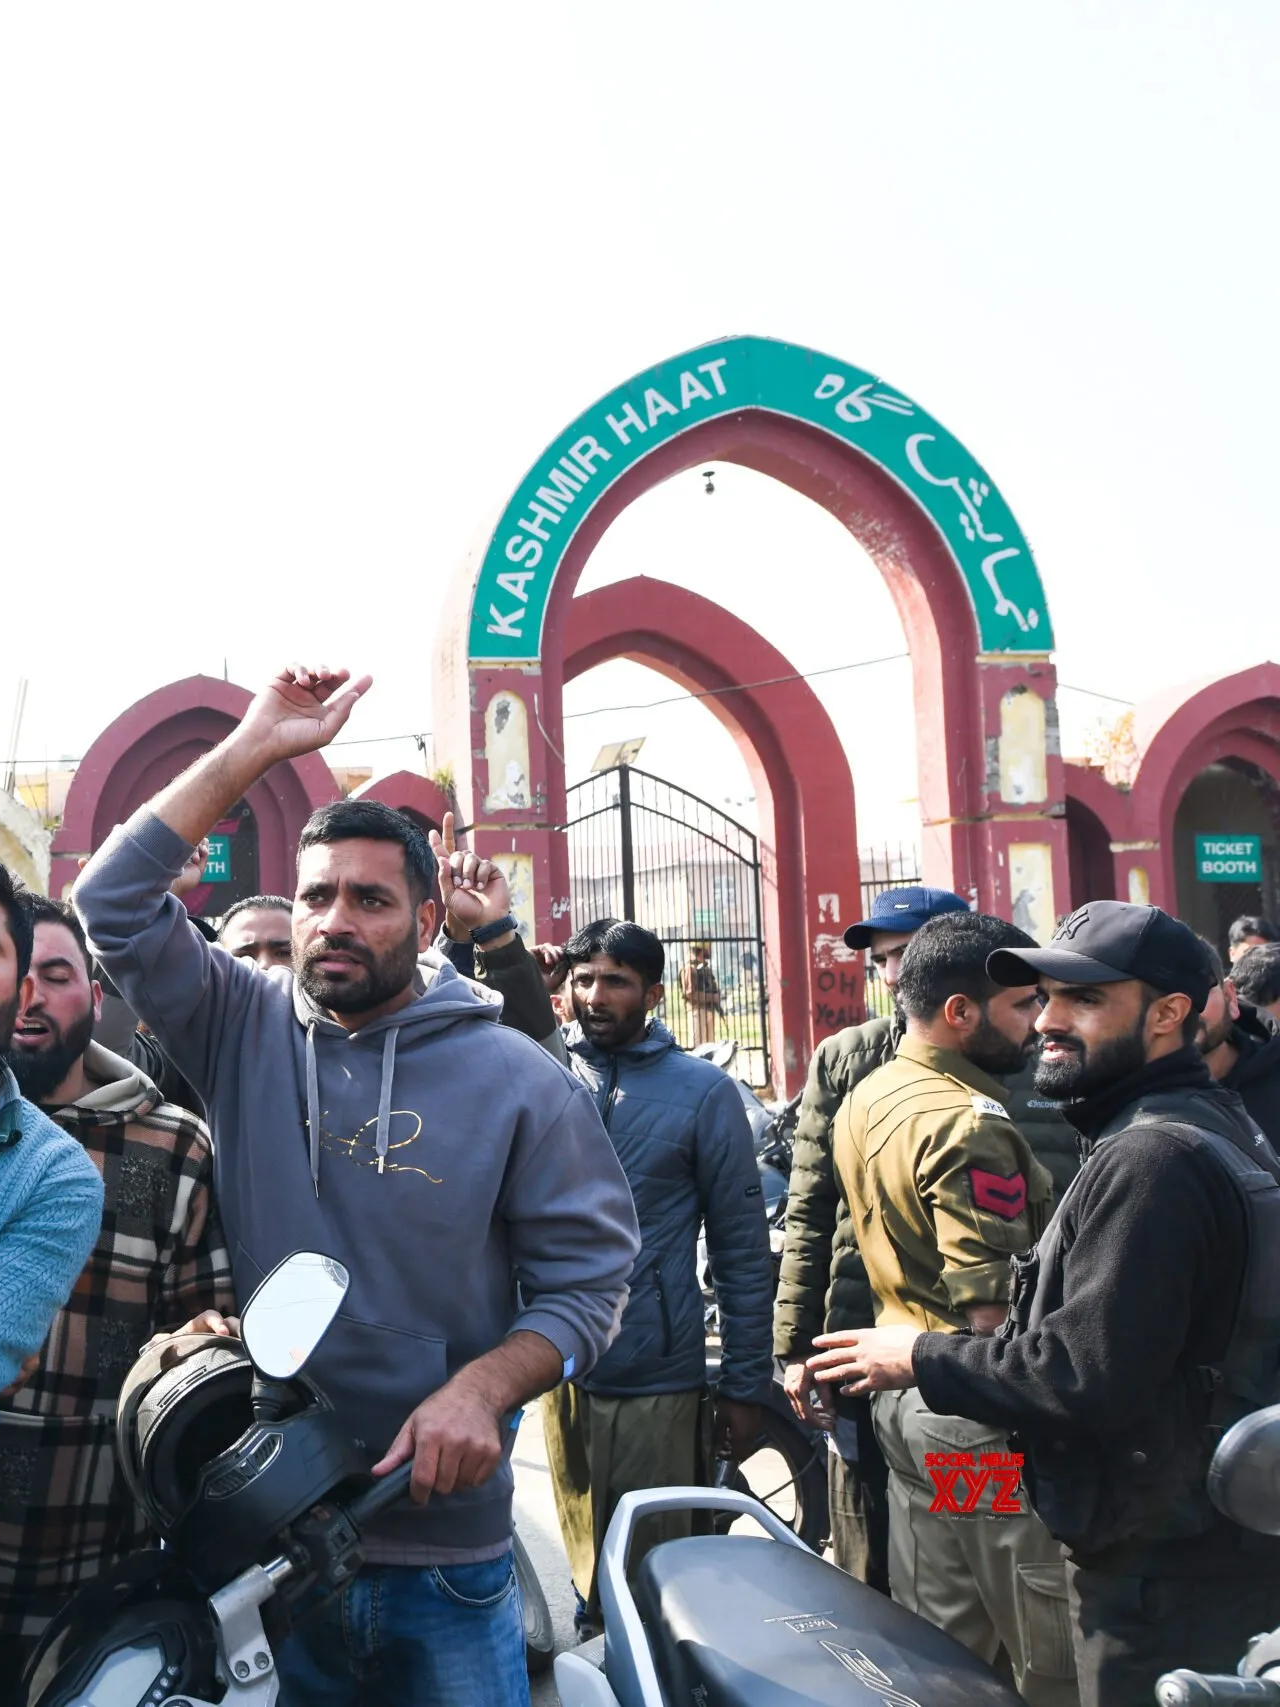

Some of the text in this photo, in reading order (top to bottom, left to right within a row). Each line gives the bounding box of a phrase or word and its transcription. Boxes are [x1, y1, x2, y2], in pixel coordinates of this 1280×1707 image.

[487, 358, 729, 638] KASHMIR HAAT
[1203, 842, 1254, 856] TICKET
[1201, 860, 1257, 874] BOOTH
[818, 969, 857, 999] OH
